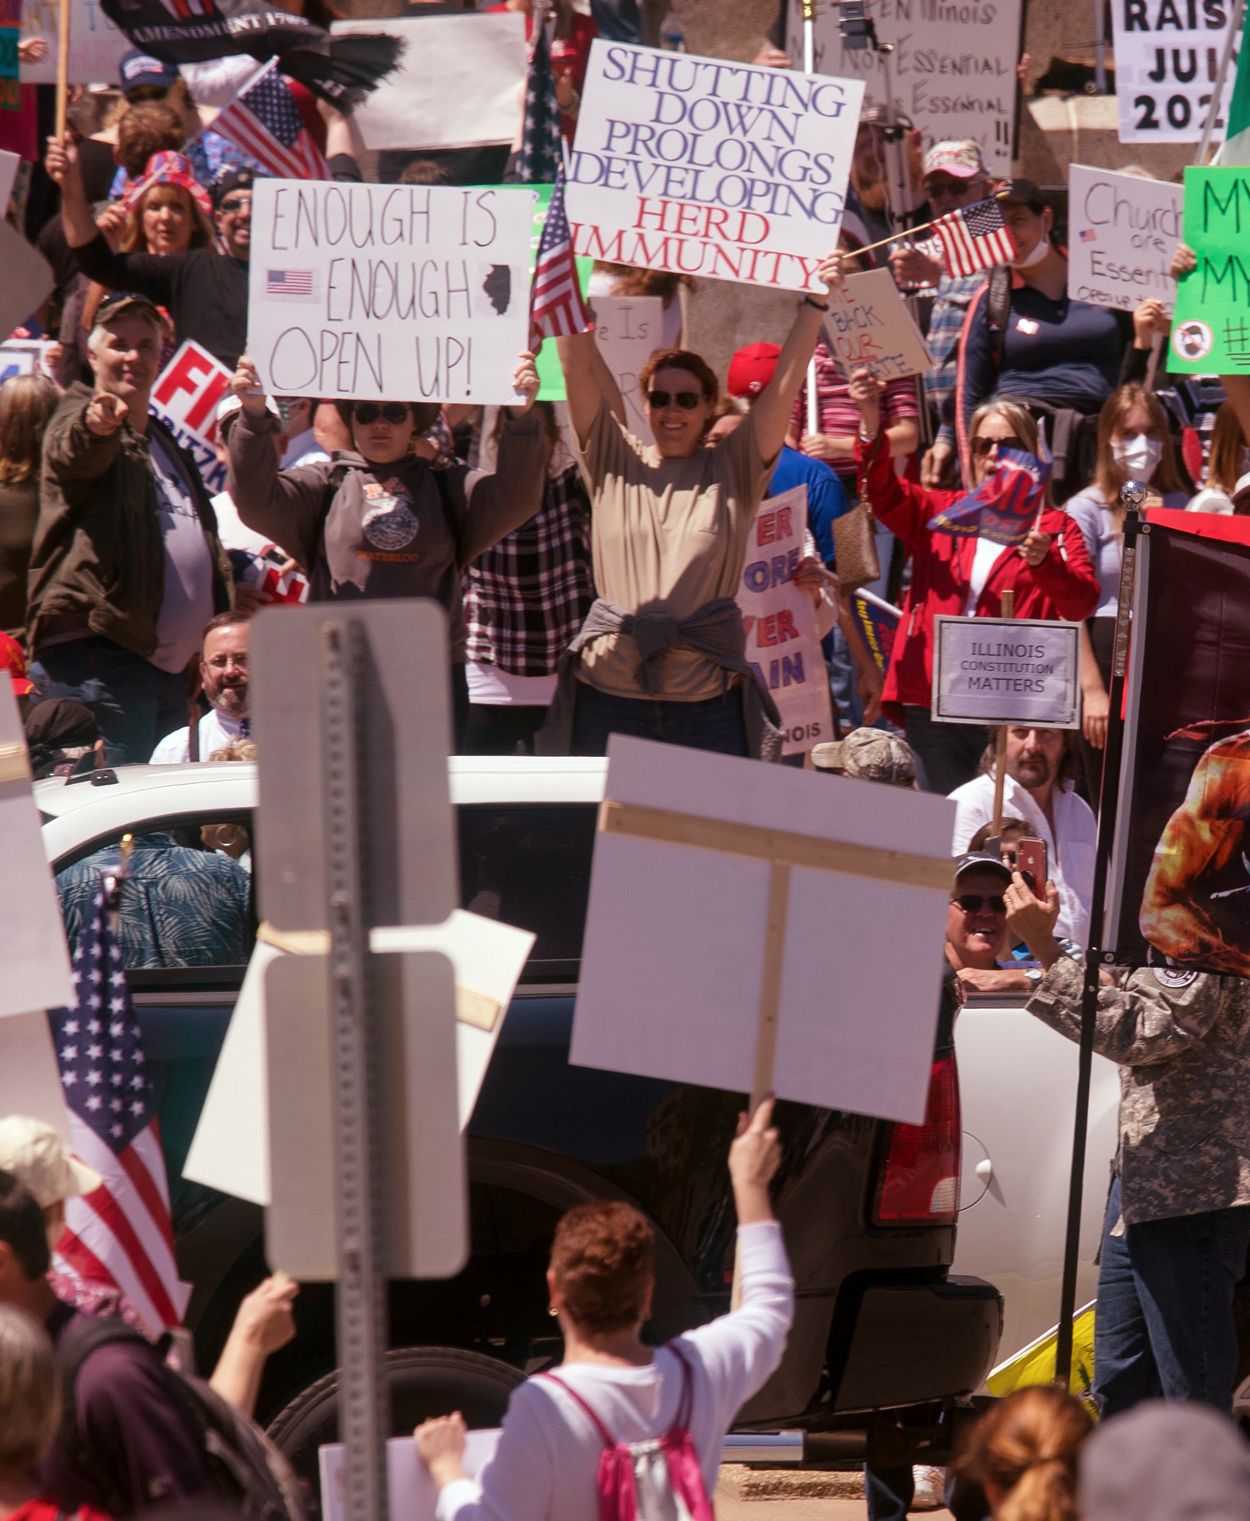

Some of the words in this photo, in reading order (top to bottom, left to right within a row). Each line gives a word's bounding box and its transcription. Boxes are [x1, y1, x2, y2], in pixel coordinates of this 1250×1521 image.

[602, 47, 849, 118] SHUTTING
[1134, 94, 1224, 130] 202
[650, 90, 804, 145] DOWN
[601, 118, 835, 186] PROLONGS
[272, 187, 431, 250] ENOUGH
[459, 190, 497, 247] IS
[569, 151, 845, 225] DEVELOPING
[632, 196, 770, 245] HERD
[570, 221, 826, 289] IMMUNITY
[326, 257, 472, 322] ENOUGH
[831, 305, 885, 332] BACK
[269, 326, 383, 393] OPEN
[415, 336, 472, 398] UP!
[154, 347, 233, 447] FI
[960, 660, 1054, 675] CONSTITUTION
[971, 641, 1045, 659] ILLINOIS
[968, 676, 1045, 693] MATTERS
